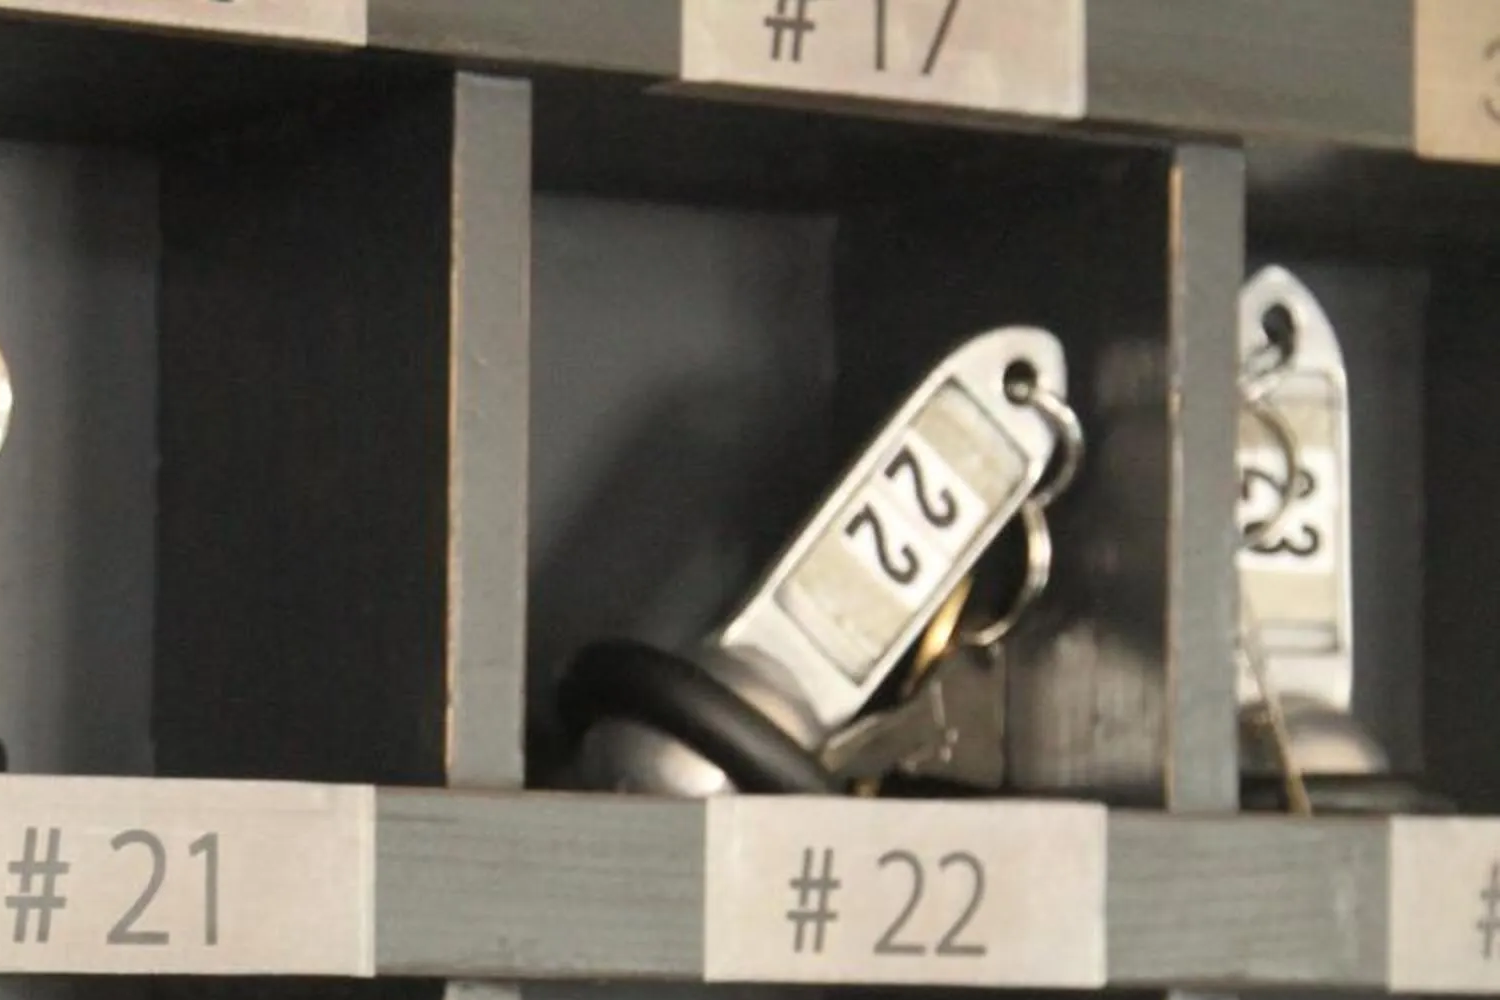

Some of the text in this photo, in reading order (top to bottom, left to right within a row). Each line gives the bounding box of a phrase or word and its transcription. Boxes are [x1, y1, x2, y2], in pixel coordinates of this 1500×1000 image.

[845, 446, 960, 586] 22
[1242, 466, 1320, 557] 23
[106, 829, 219, 945] 21
[873, 849, 988, 957] 22
